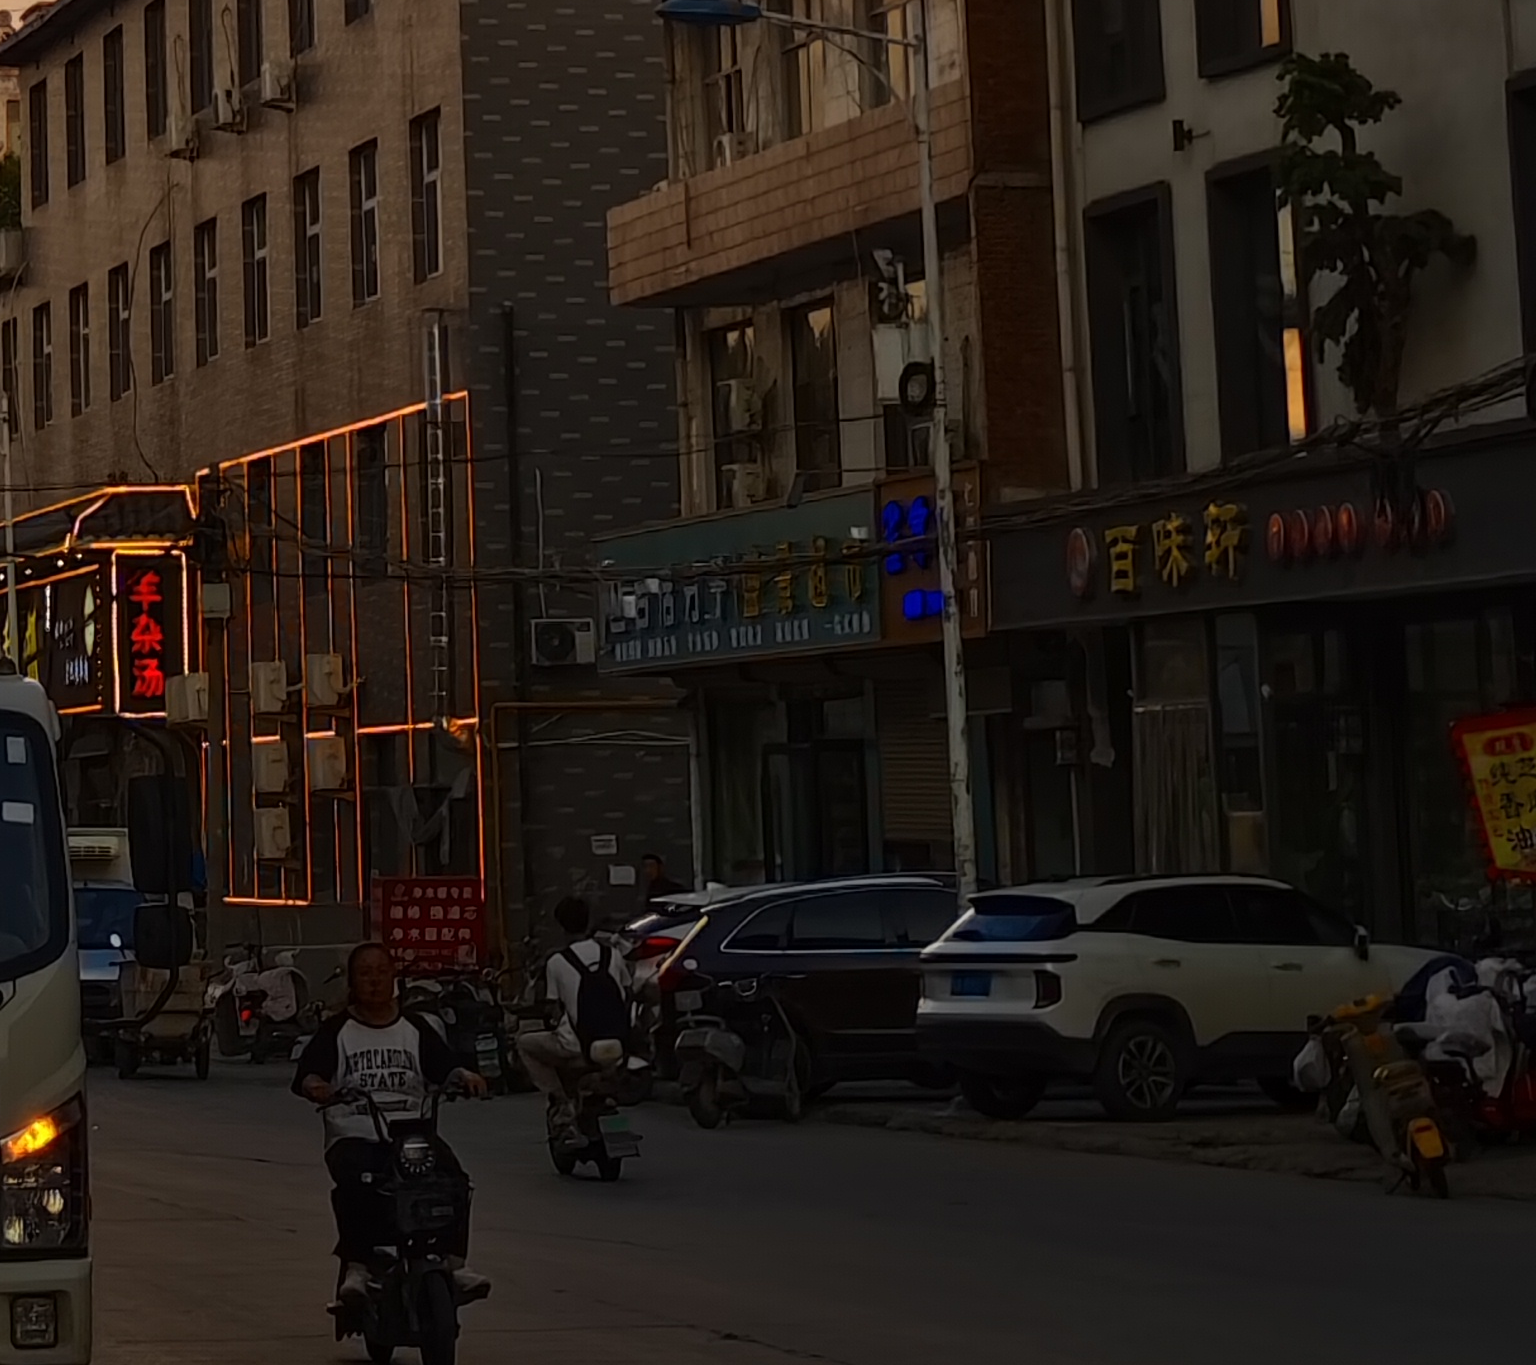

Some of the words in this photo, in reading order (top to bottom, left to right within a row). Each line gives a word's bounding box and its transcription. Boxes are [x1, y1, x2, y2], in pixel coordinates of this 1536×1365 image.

[1103, 498, 1250, 595] 百味轩
[128, 569, 166, 699] 羊杂汤
[359, 1071, 407, 1088] STATE
